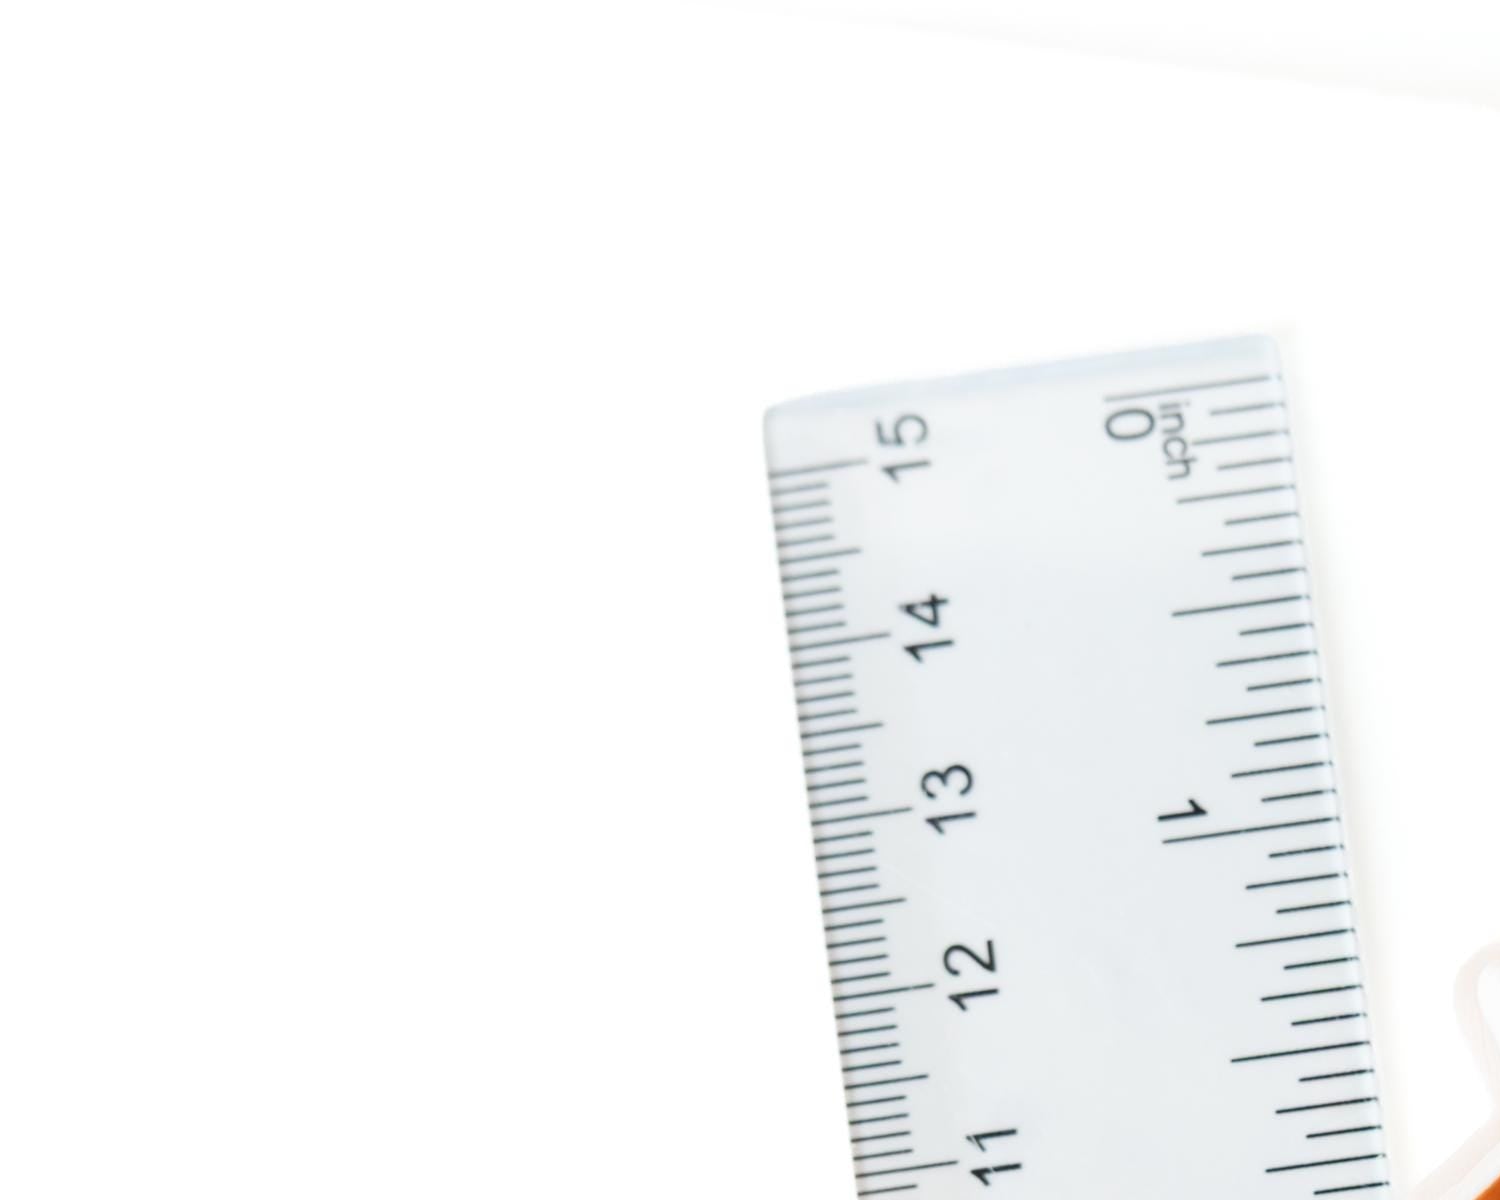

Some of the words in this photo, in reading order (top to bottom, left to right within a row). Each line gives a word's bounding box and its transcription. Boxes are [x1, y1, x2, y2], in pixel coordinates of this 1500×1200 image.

[875, 414, 931, 483] 15
[1105, 407, 1157, 442] 0
[1159, 402, 1196, 480] inch
[898, 593, 955, 664] 14
[919, 763, 977, 835] 13
[1156, 798, 1208, 822] 1
[942, 939, 1000, 1012] 12
[965, 1128, 1023, 1186] 11
